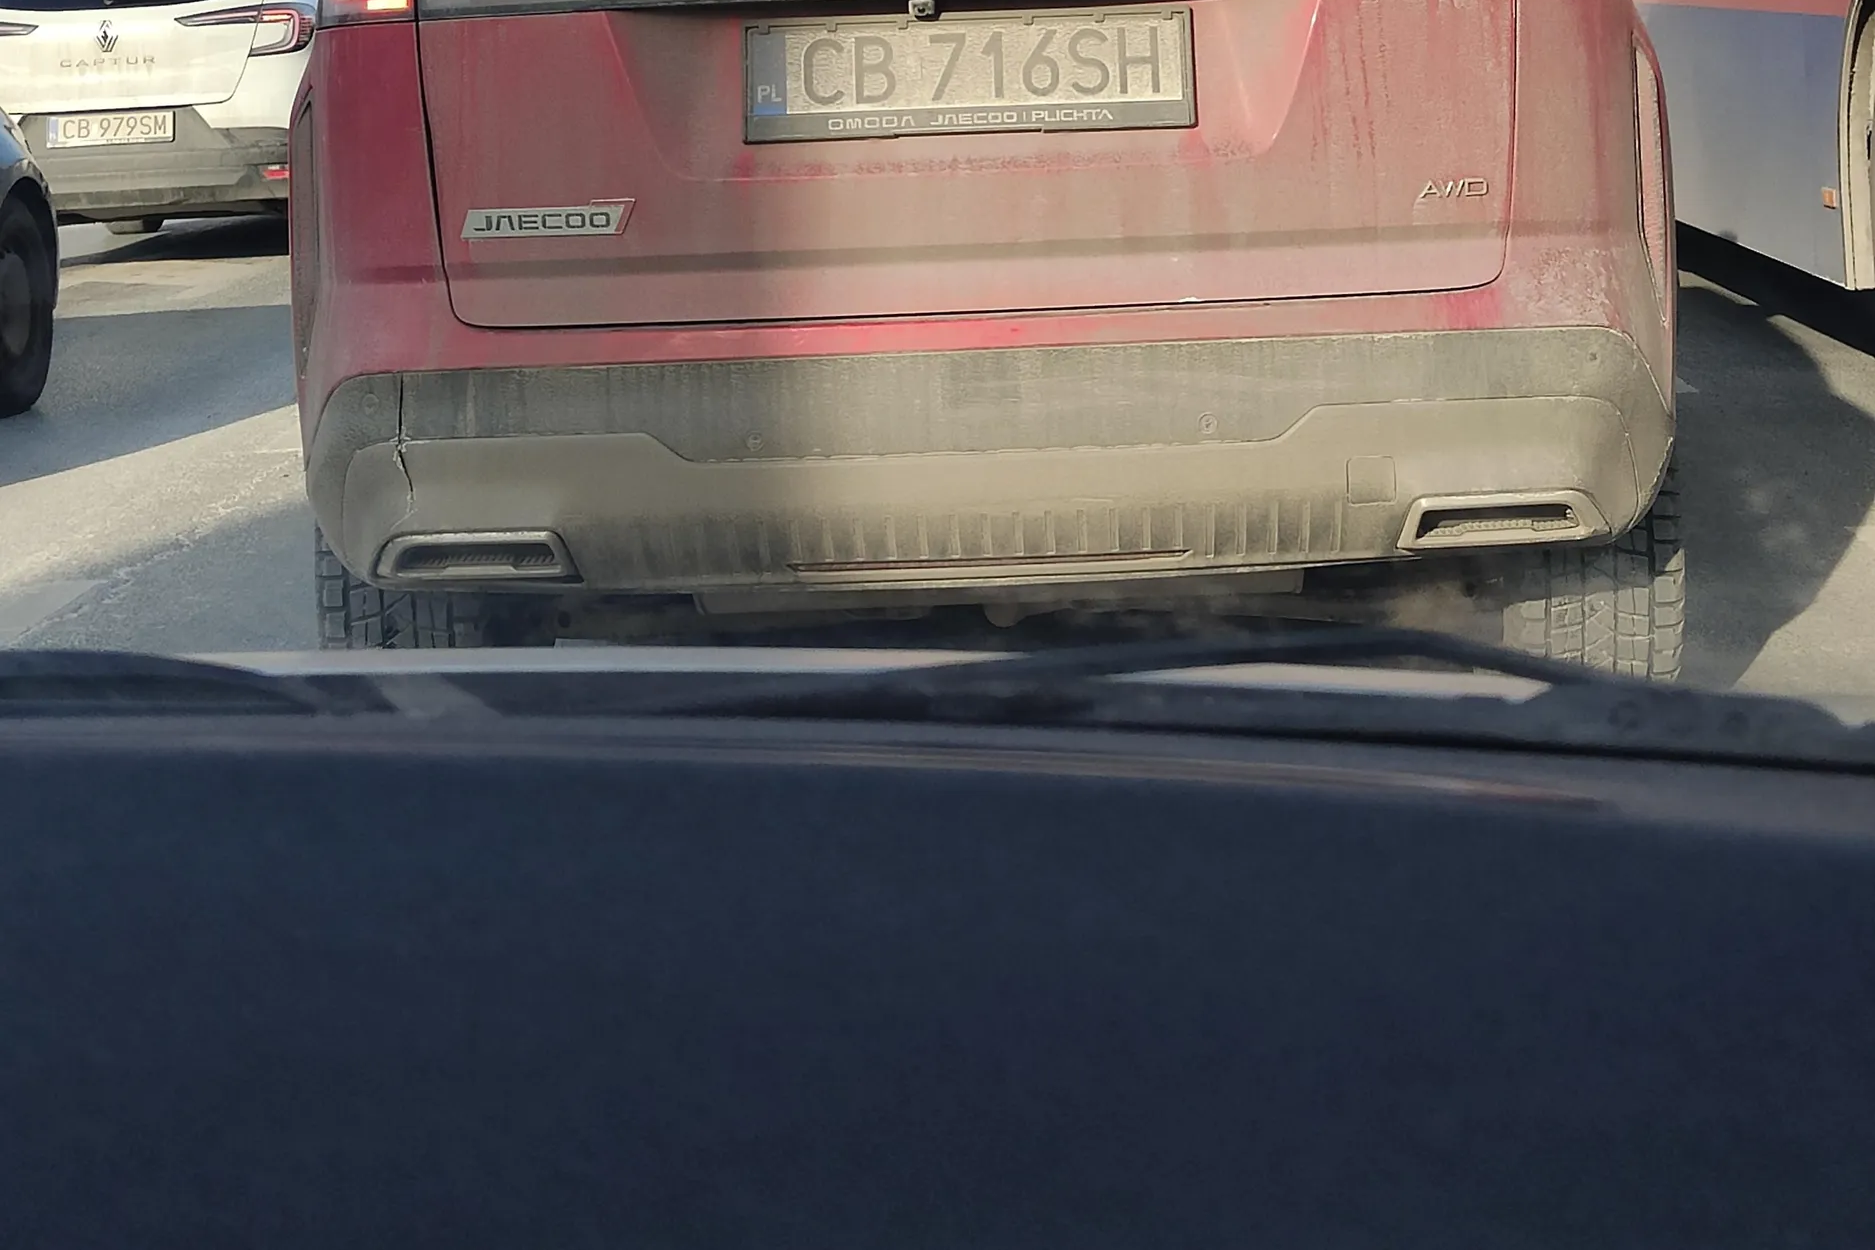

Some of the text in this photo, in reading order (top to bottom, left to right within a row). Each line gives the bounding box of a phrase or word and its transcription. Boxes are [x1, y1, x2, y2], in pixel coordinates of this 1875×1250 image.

[60, 55, 155, 68] CAPTUR
[803, 25, 1161, 105] CB 716SH
[757, 84, 782, 103] PL
[63, 118, 90, 139] CB
[100, 115, 167, 138] 979SM
[828, 109, 1113, 131] OMODA JAECOO PLICHTA
[1420, 177, 1489, 199] AWD
[473, 211, 611, 232] JAECOO
